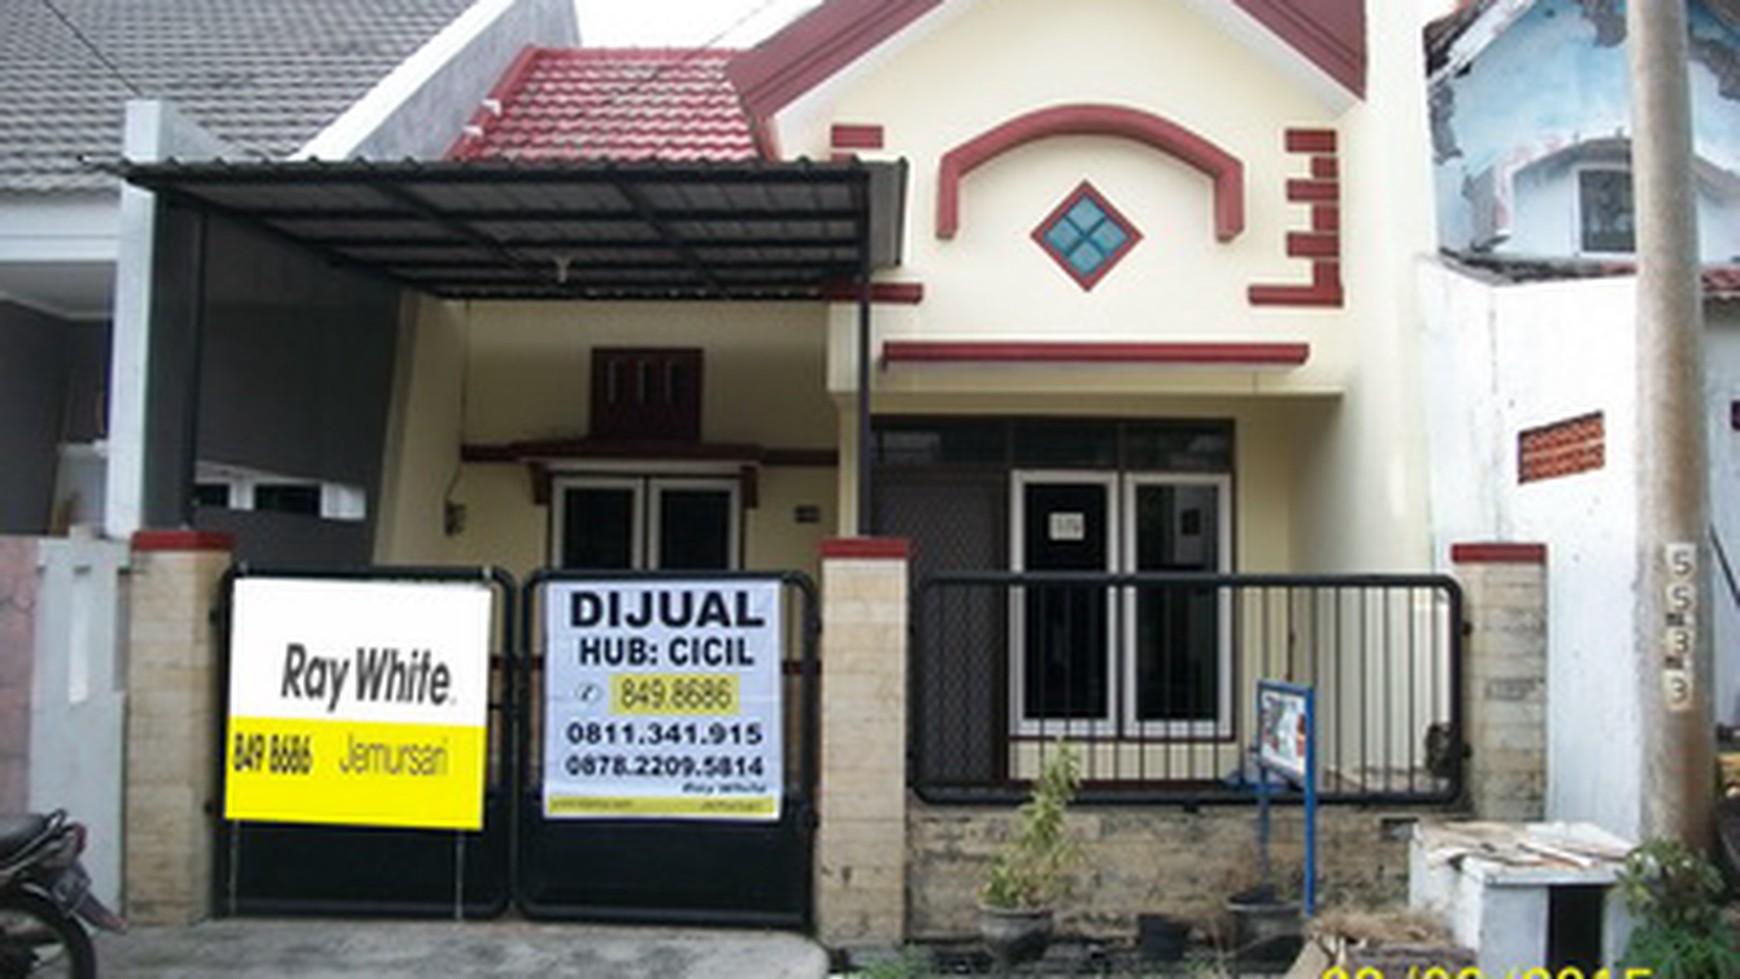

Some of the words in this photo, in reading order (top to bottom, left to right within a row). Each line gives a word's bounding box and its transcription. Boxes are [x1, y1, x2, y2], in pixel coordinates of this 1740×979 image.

[570, 591, 765, 627] DIJUAL
[580, 637, 658, 665] HUB:
[669, 637, 754, 665] CICIL
[281, 643, 350, 713] Ray
[355, 647, 451, 705] White
[621, 678, 732, 710] 849.8686
[566, 722, 763, 745] 0811.341.915
[339, 734, 448, 776] Jemursari
[565, 754, 765, 777] 0878.2209.5814
